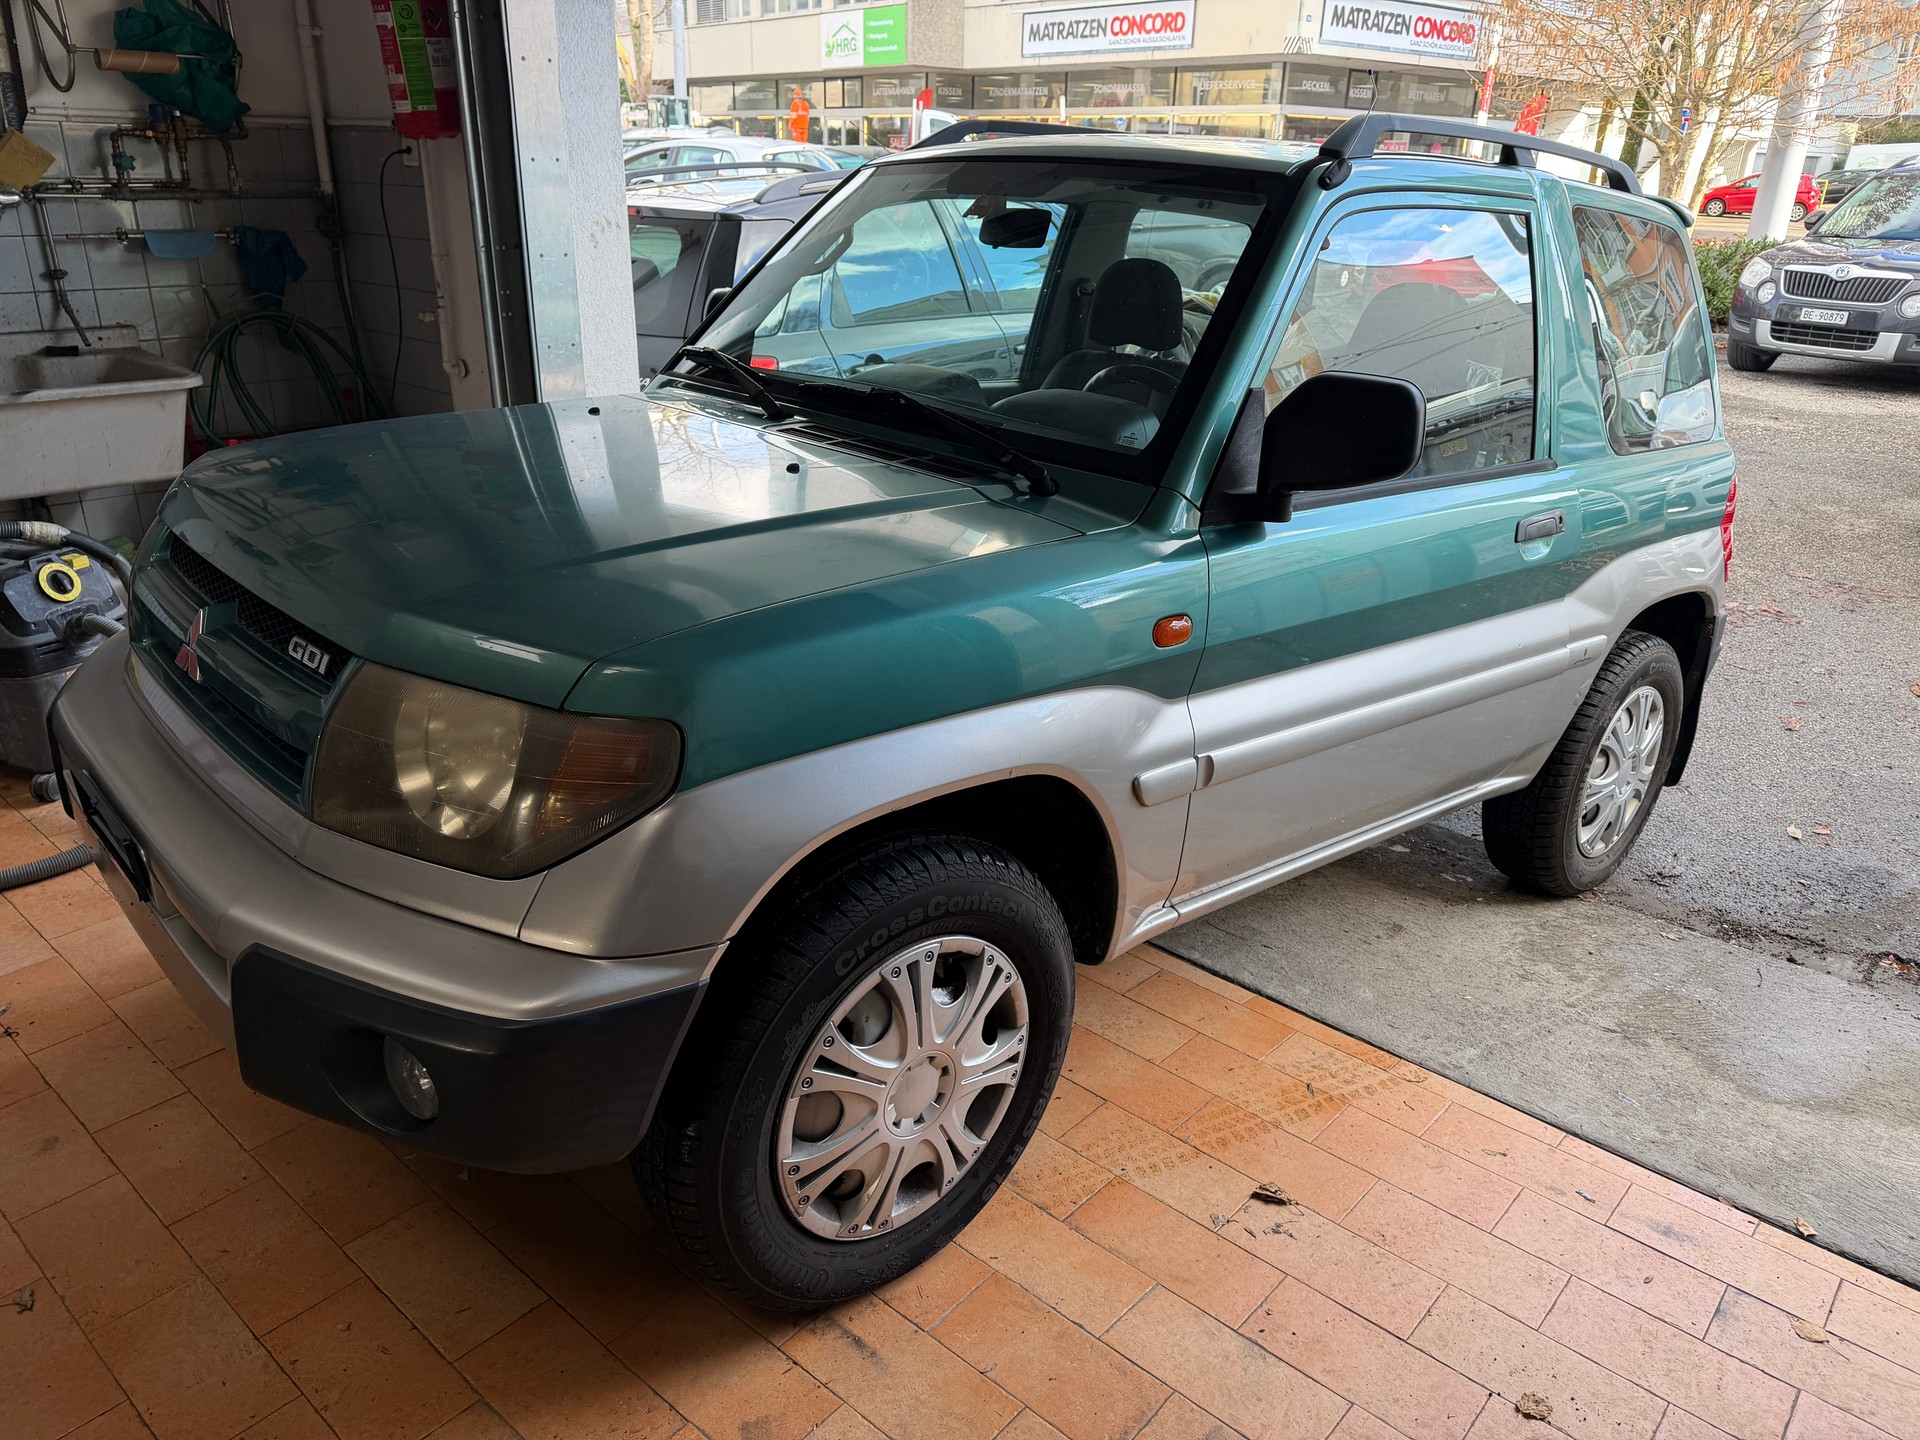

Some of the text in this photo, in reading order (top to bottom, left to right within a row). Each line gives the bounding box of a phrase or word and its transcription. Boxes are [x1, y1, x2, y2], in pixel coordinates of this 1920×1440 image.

[1028, 11, 1186, 42] MATRATZEN CONCORD
[1330, 4, 1477, 45] MATRATZEN CONCORD
[836, 37, 857, 53] HRG
[1199, 79, 1256, 90] LIEFERSERVICE
[1302, 80, 1330, 90] DECKEN
[938, 87, 962, 96] KISSEN
[989, 86, 1049, 97] KINDERMATRATZEN
[1349, 88, 1372, 99] KISSEN
[889, 136, 907, 148] SALE
[288, 635, 331, 676] GDI
